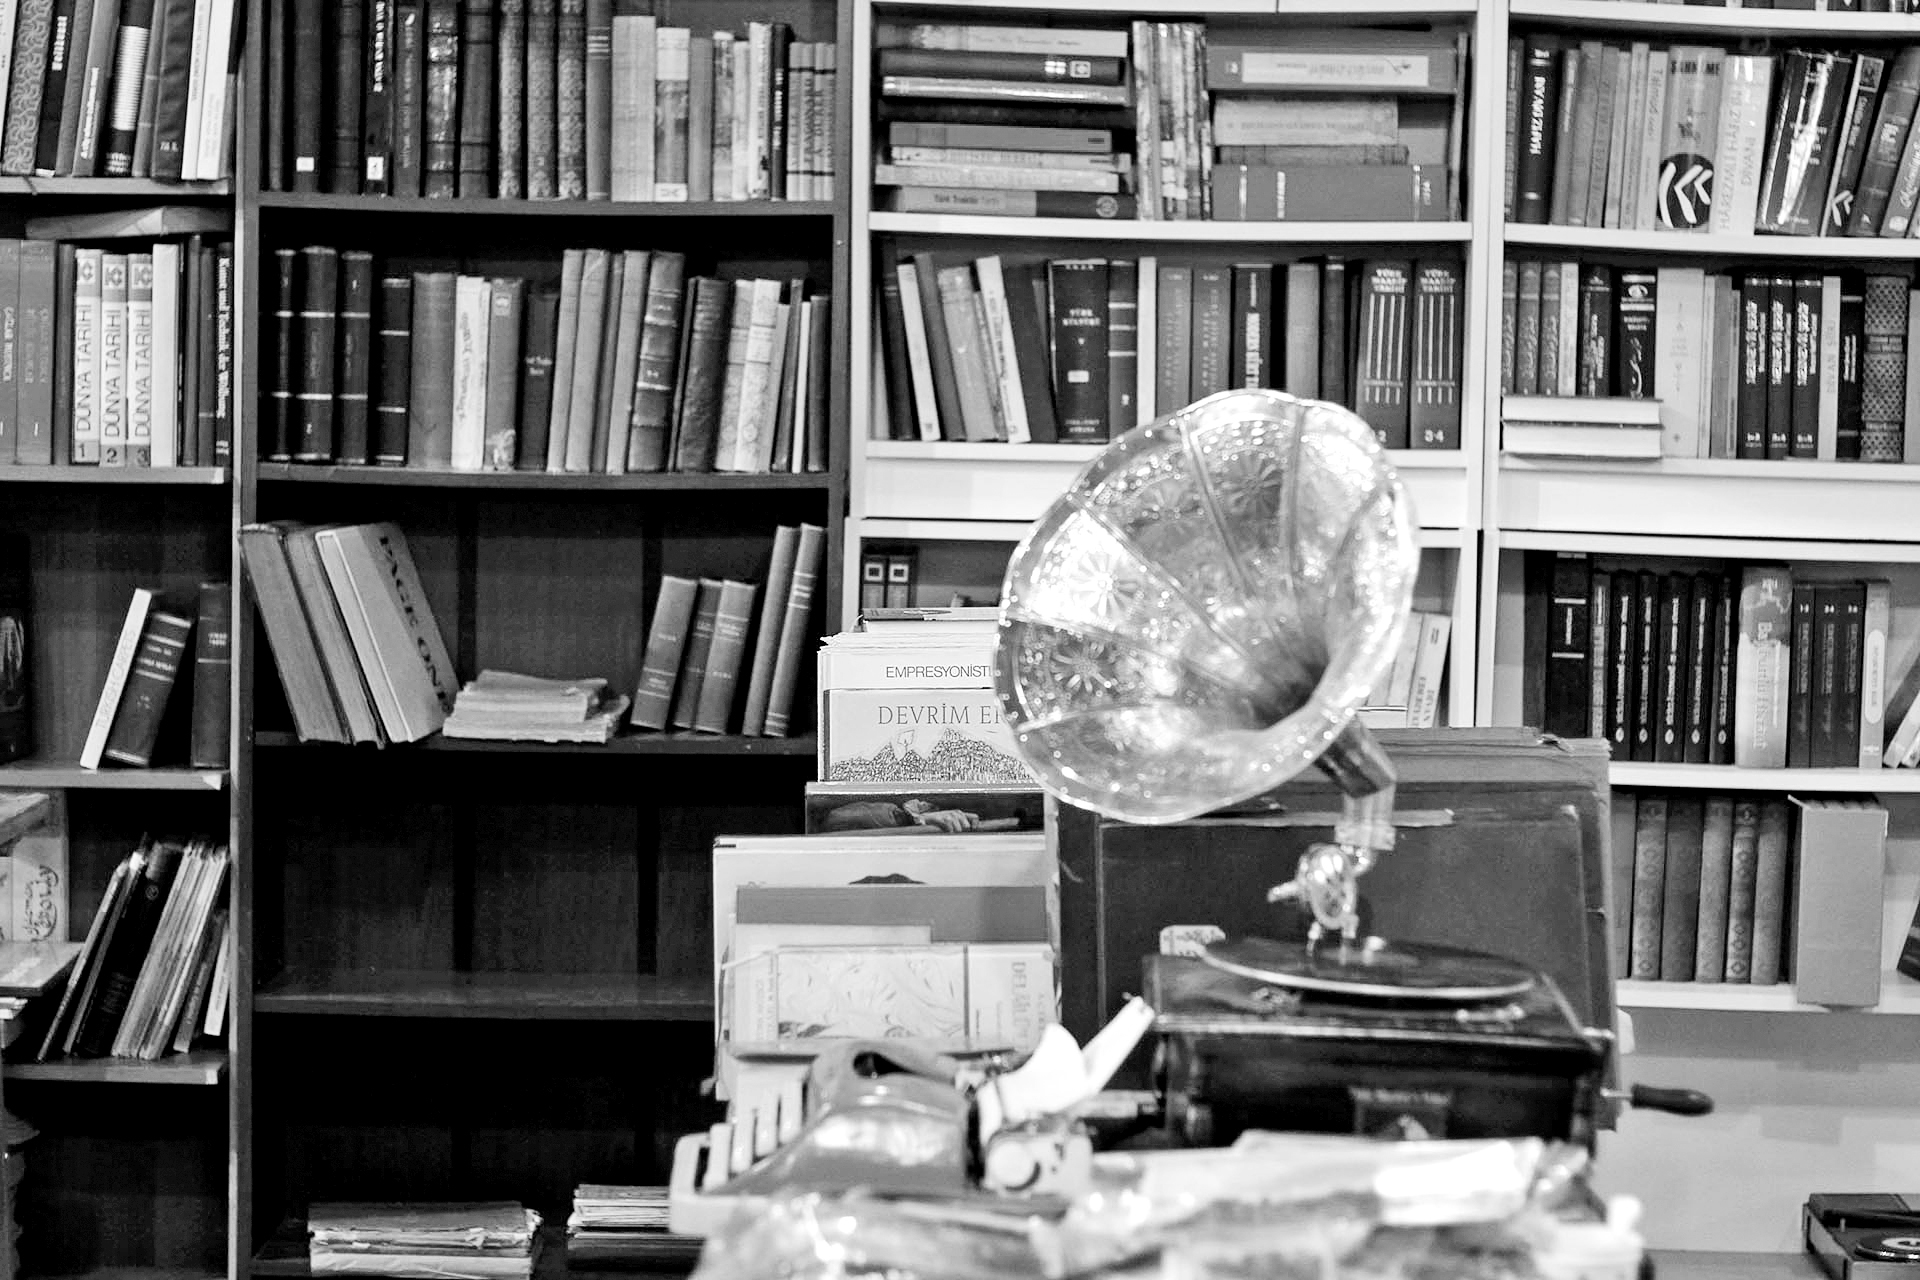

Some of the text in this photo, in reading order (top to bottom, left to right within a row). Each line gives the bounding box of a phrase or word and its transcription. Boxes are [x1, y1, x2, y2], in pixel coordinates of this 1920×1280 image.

[103, 376, 120, 438] DÜNYA
[79, 443, 86, 458] 1
[106, 448, 117, 464] 2
[137, 448, 149, 467] 3
[878, 703, 970, 725] DEVRİM
